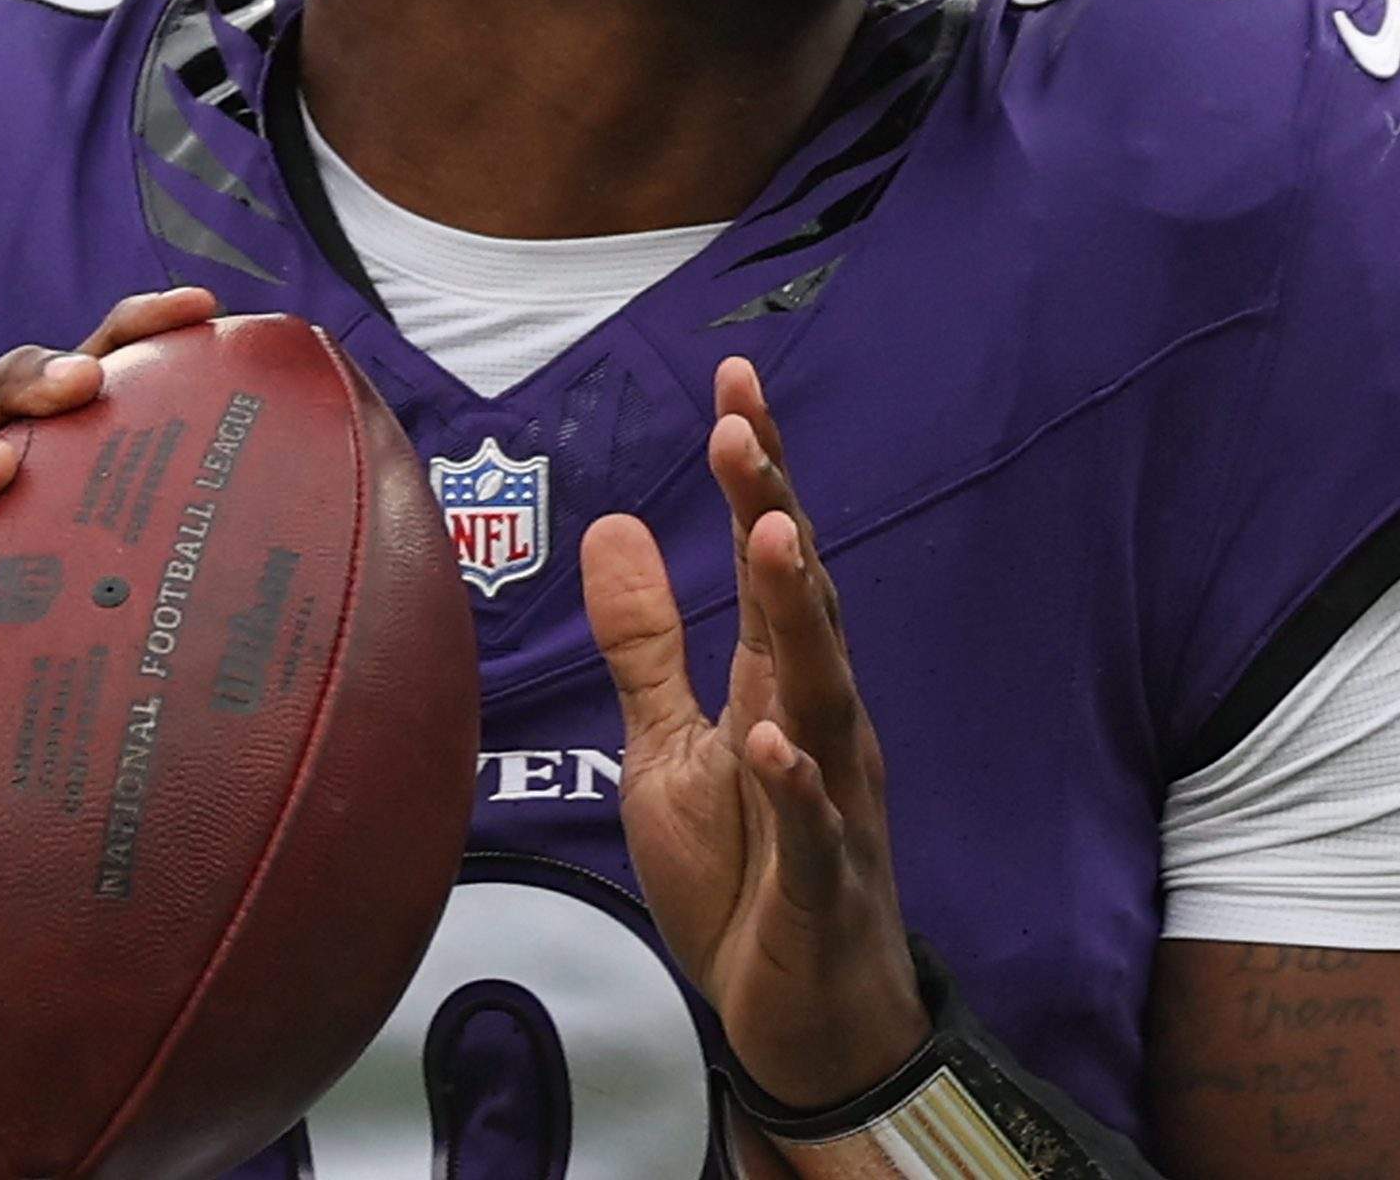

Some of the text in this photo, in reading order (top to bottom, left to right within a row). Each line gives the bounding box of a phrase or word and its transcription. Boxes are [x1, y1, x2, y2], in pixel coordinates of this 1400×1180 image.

[140, 499, 218, 679] FOOTBALL
[195, 393, 264, 490] LEAGUE
[450, 513, 529, 569] NFL
